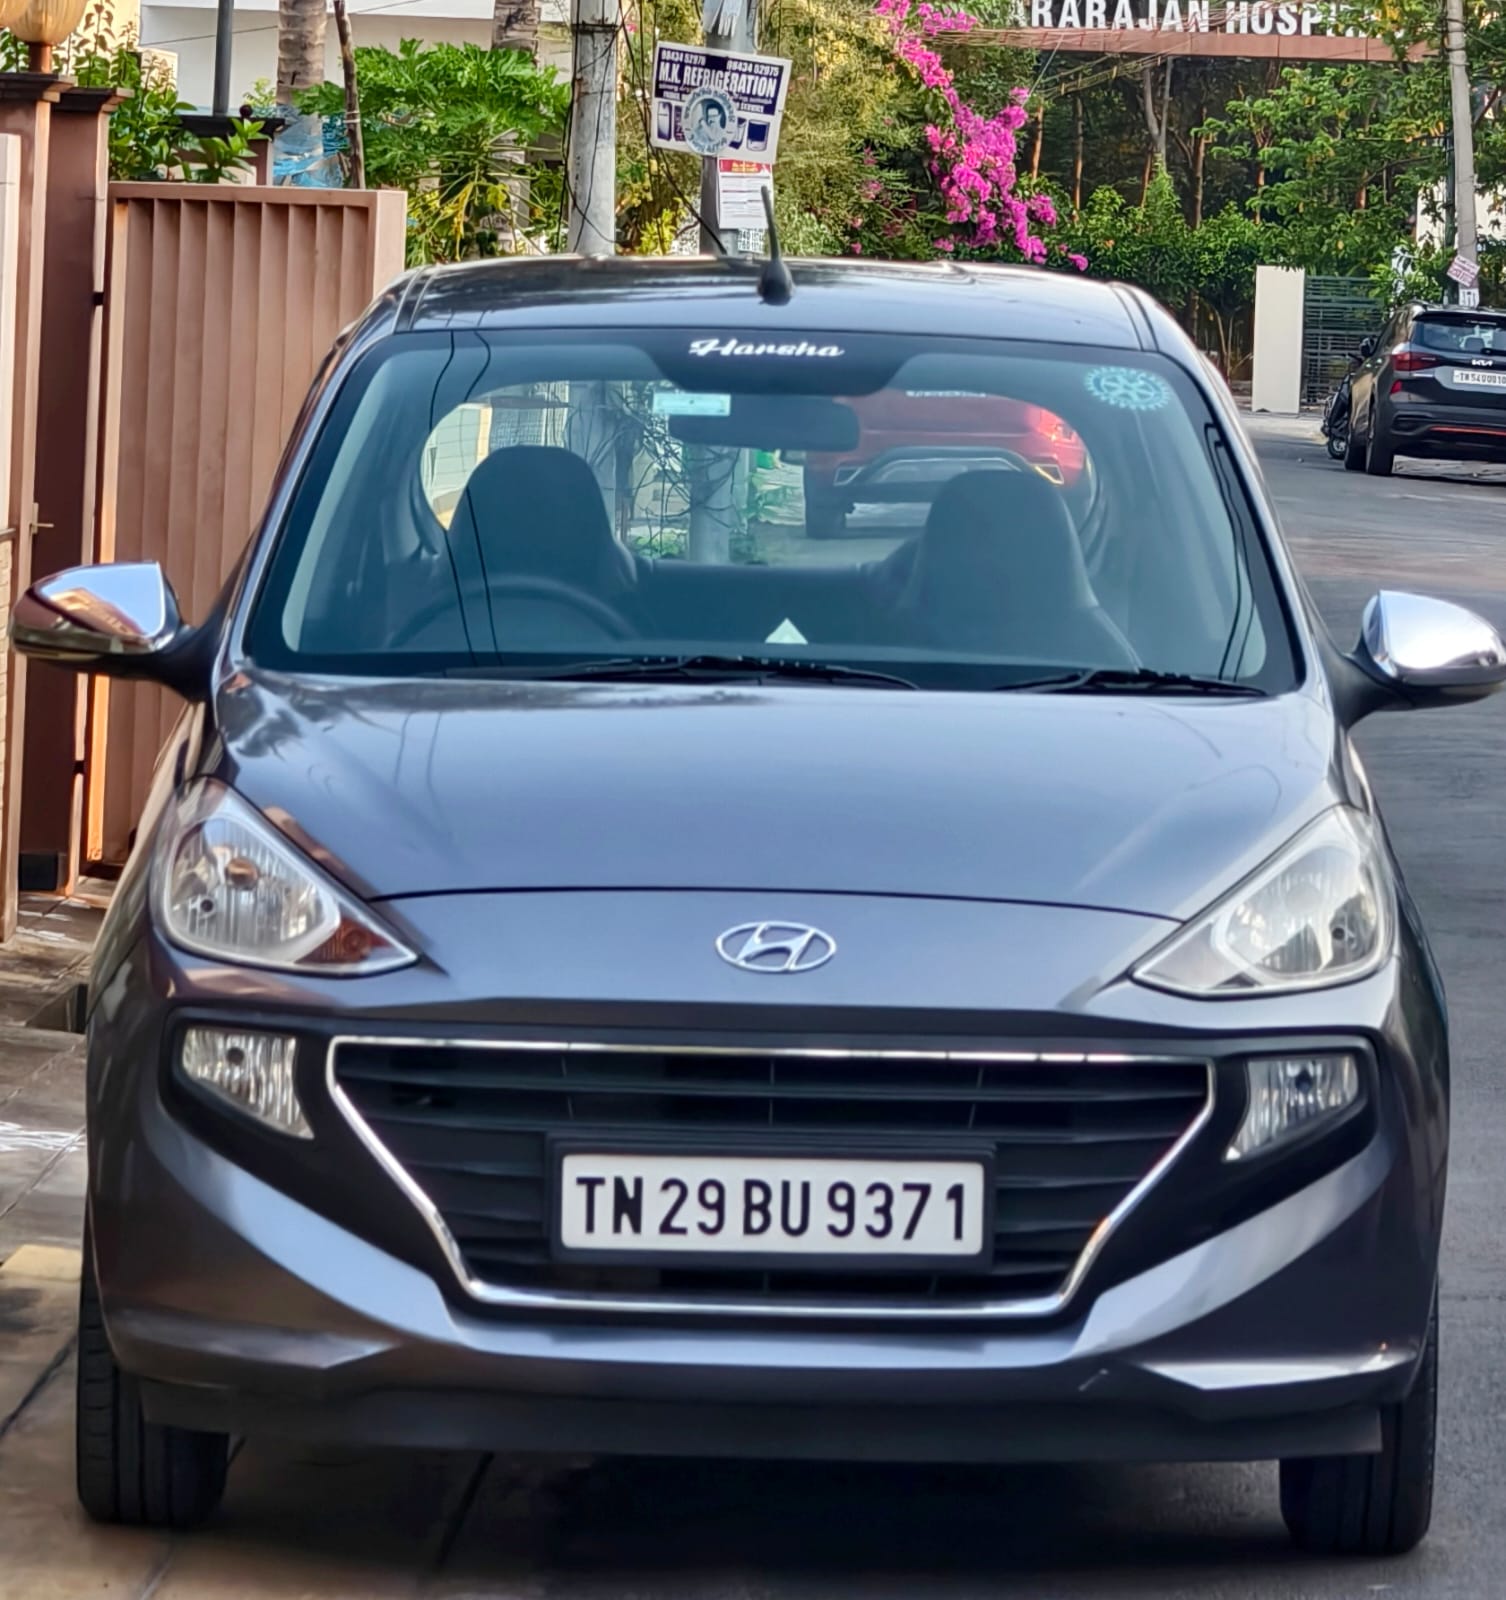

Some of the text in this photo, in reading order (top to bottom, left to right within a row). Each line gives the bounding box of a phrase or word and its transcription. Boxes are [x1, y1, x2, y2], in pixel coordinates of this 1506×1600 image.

[683, 66, 778, 98] REFRIGERATION
[575, 1176, 966, 1241] TN 29 BU 9371
